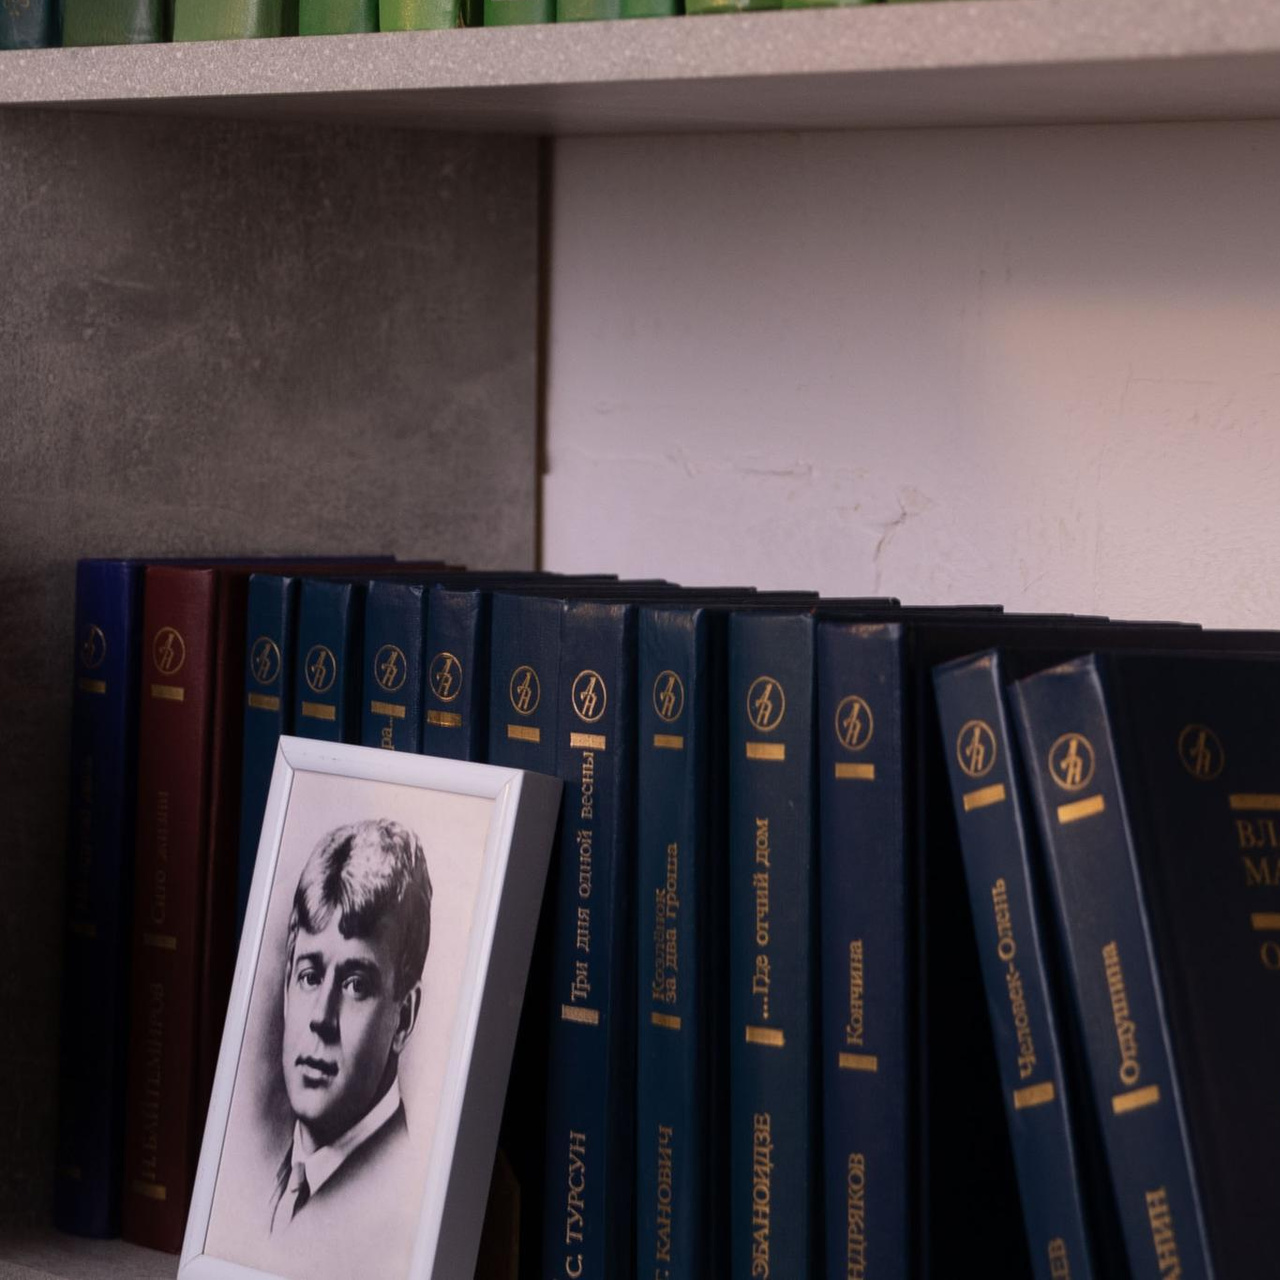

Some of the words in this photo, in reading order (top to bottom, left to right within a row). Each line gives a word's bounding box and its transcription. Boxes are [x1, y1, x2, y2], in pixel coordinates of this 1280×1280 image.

[581, 751, 595, 820] весны
[577, 829, 593, 899] одной
[755, 817, 771, 866] дом
[666, 841, 679, 919] гроша
[753, 872, 769, 947] отчий
[576, 906, 591, 953] дня
[666, 927, 678, 971] два
[571, 961, 591, 1002] Три
[666, 977, 677, 1005] за
[846, 938, 863, 1046] Кончина
[991, 877, 1036, 1080] Человек-Олень
[1102, 940, 1140, 1085] Отдушина
[565, 1129, 586, 1246] ТУРСУН
[655, 1124, 673, 1263] КАНОВИЧ
